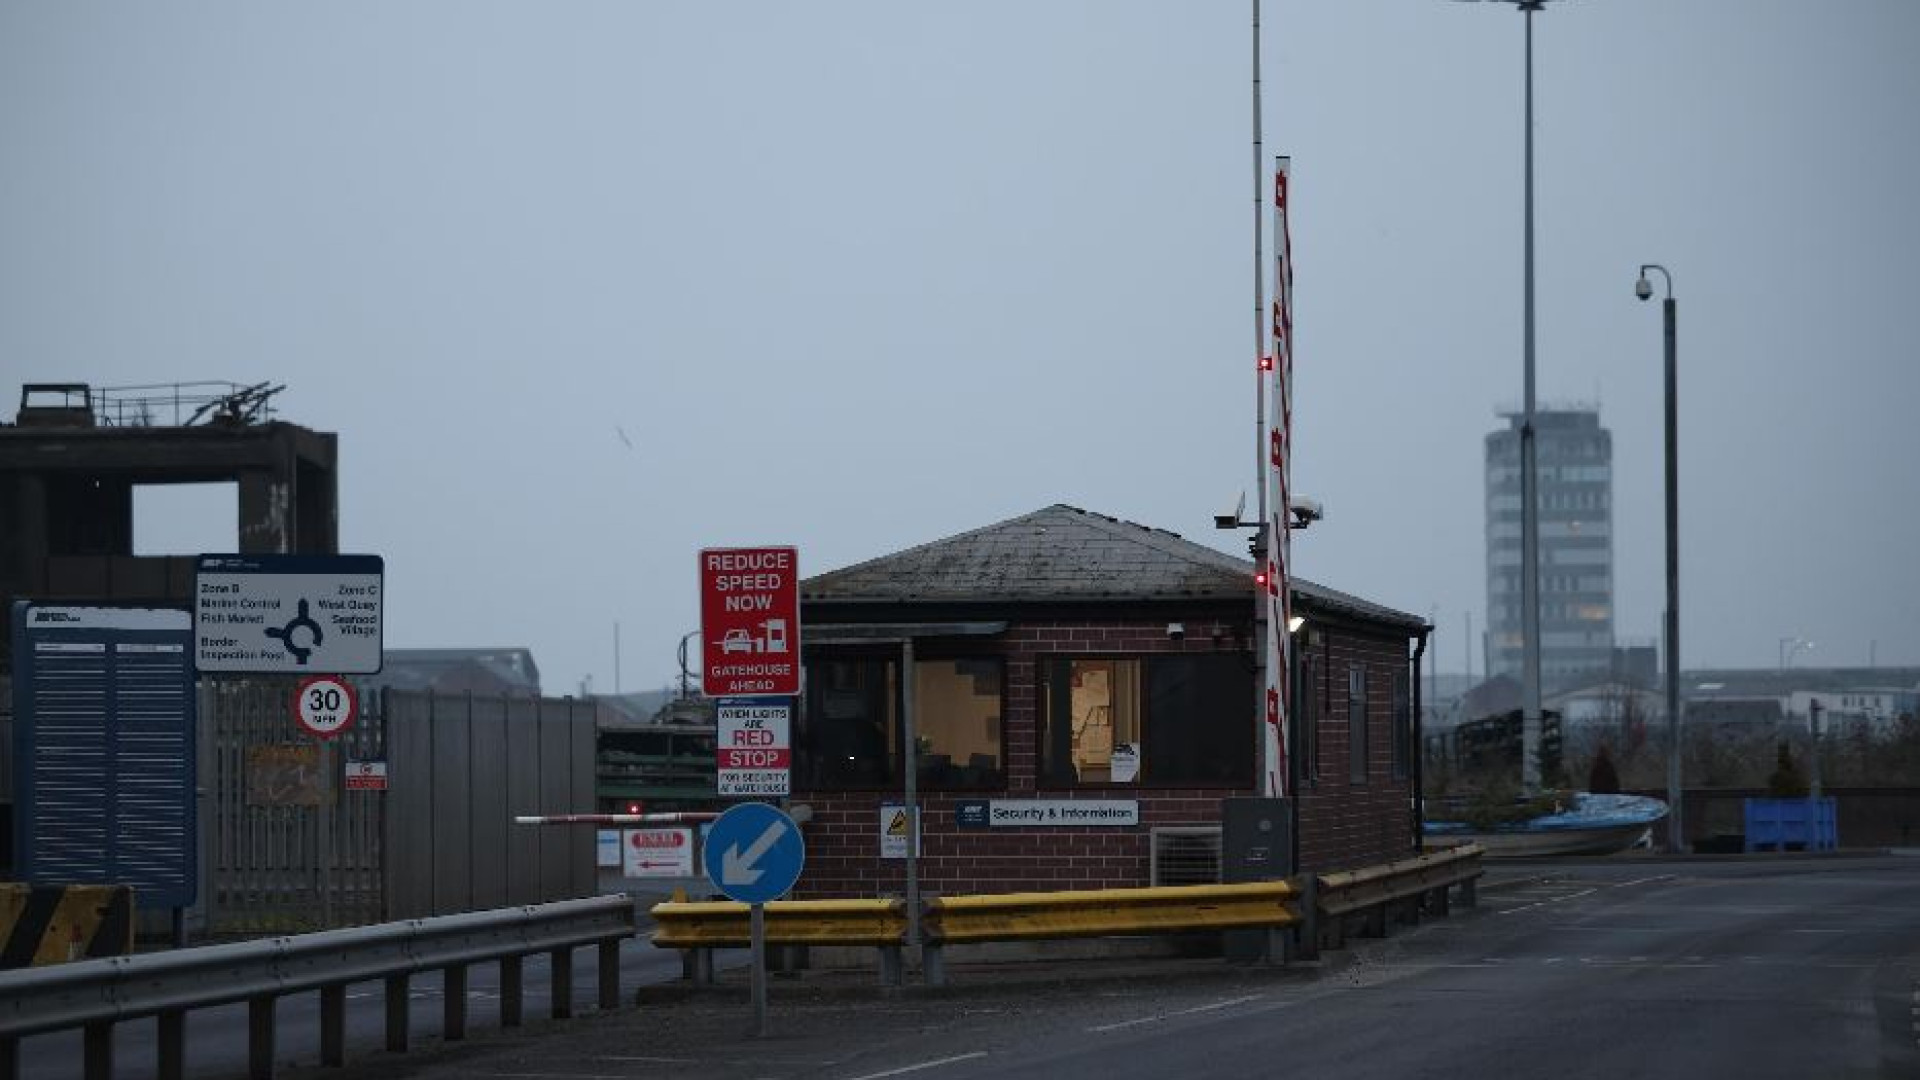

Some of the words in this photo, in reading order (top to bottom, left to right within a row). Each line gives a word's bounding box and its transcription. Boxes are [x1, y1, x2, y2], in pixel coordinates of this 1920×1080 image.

[708, 553, 789, 571] REDUCE
[716, 573, 781, 591] SPEED
[201, 584, 229, 593] Zone
[339, 586, 365, 595] Zone
[368, 586, 377, 595] C
[201, 599, 238, 608] Marine
[240, 599, 281, 608] Control
[319, 600, 346, 609] West
[348, 600, 377, 611] Quay
[725, 594, 773, 611] NOW
[201, 614, 225, 623] Fish
[228, 614, 264, 623] Market
[332, 615, 377, 624] Seafood
[339, 625, 377, 638] Village
[201, 637, 238, 647] Border
[201, 650, 257, 661] Inspection
[261, 650, 285, 660] Post
[712, 664, 791, 677] GATEHOUSE
[729, 680, 774, 691] AHEAD
[310, 689, 340, 711] 30
[720, 709, 750, 718] WHEN
[753, 709, 787, 718] LIGHTS
[744, 720, 764, 728] ARE
[733, 730, 774, 746] RED
[730, 751, 779, 766] STOP
[721, 773, 740, 782] FOR
[743, 773, 787, 782] SECURITY
[720, 784, 731, 793] AT
[734, 784, 787, 793] GATEHOUSE
[993, 806, 1044, 821] Security
[1048, 808, 1057, 819] &
[1062, 807, 1133, 819] Information
